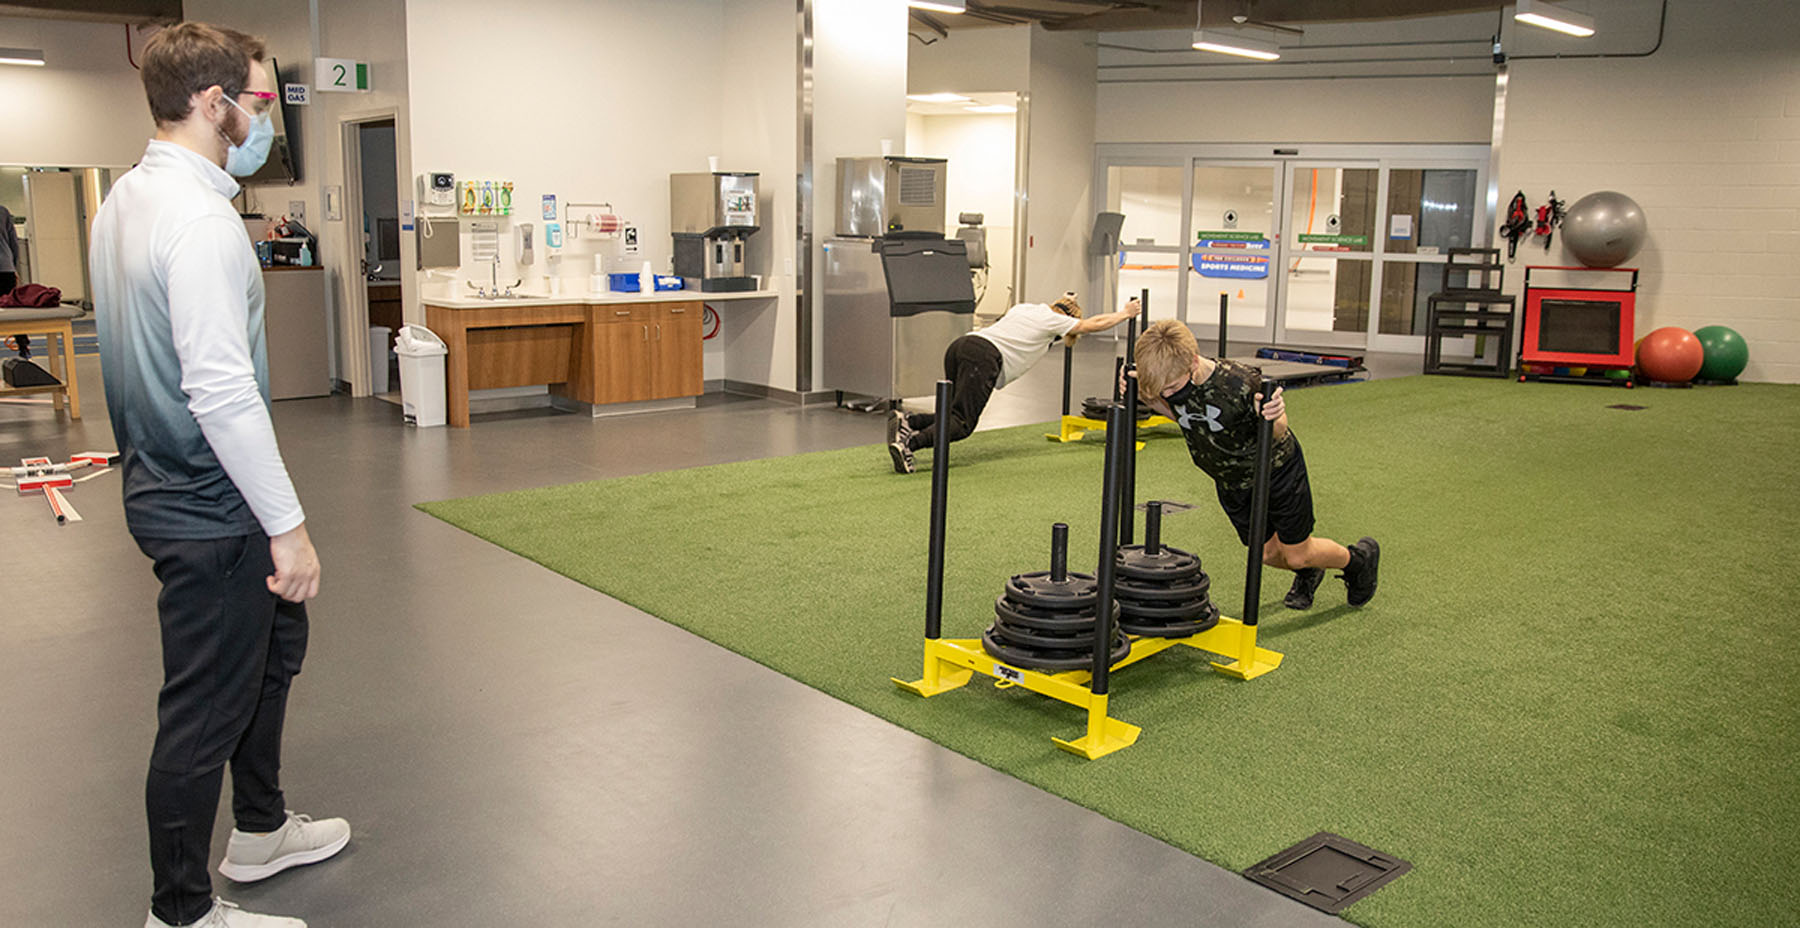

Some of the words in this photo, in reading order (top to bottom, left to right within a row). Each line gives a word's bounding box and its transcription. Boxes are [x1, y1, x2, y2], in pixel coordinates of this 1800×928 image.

[333, 64, 346, 86] 2
[287, 94, 306, 102] GAS
[1201, 263, 1228, 271] SPORTS
[1230, 264, 1266, 272] MEDICINE
